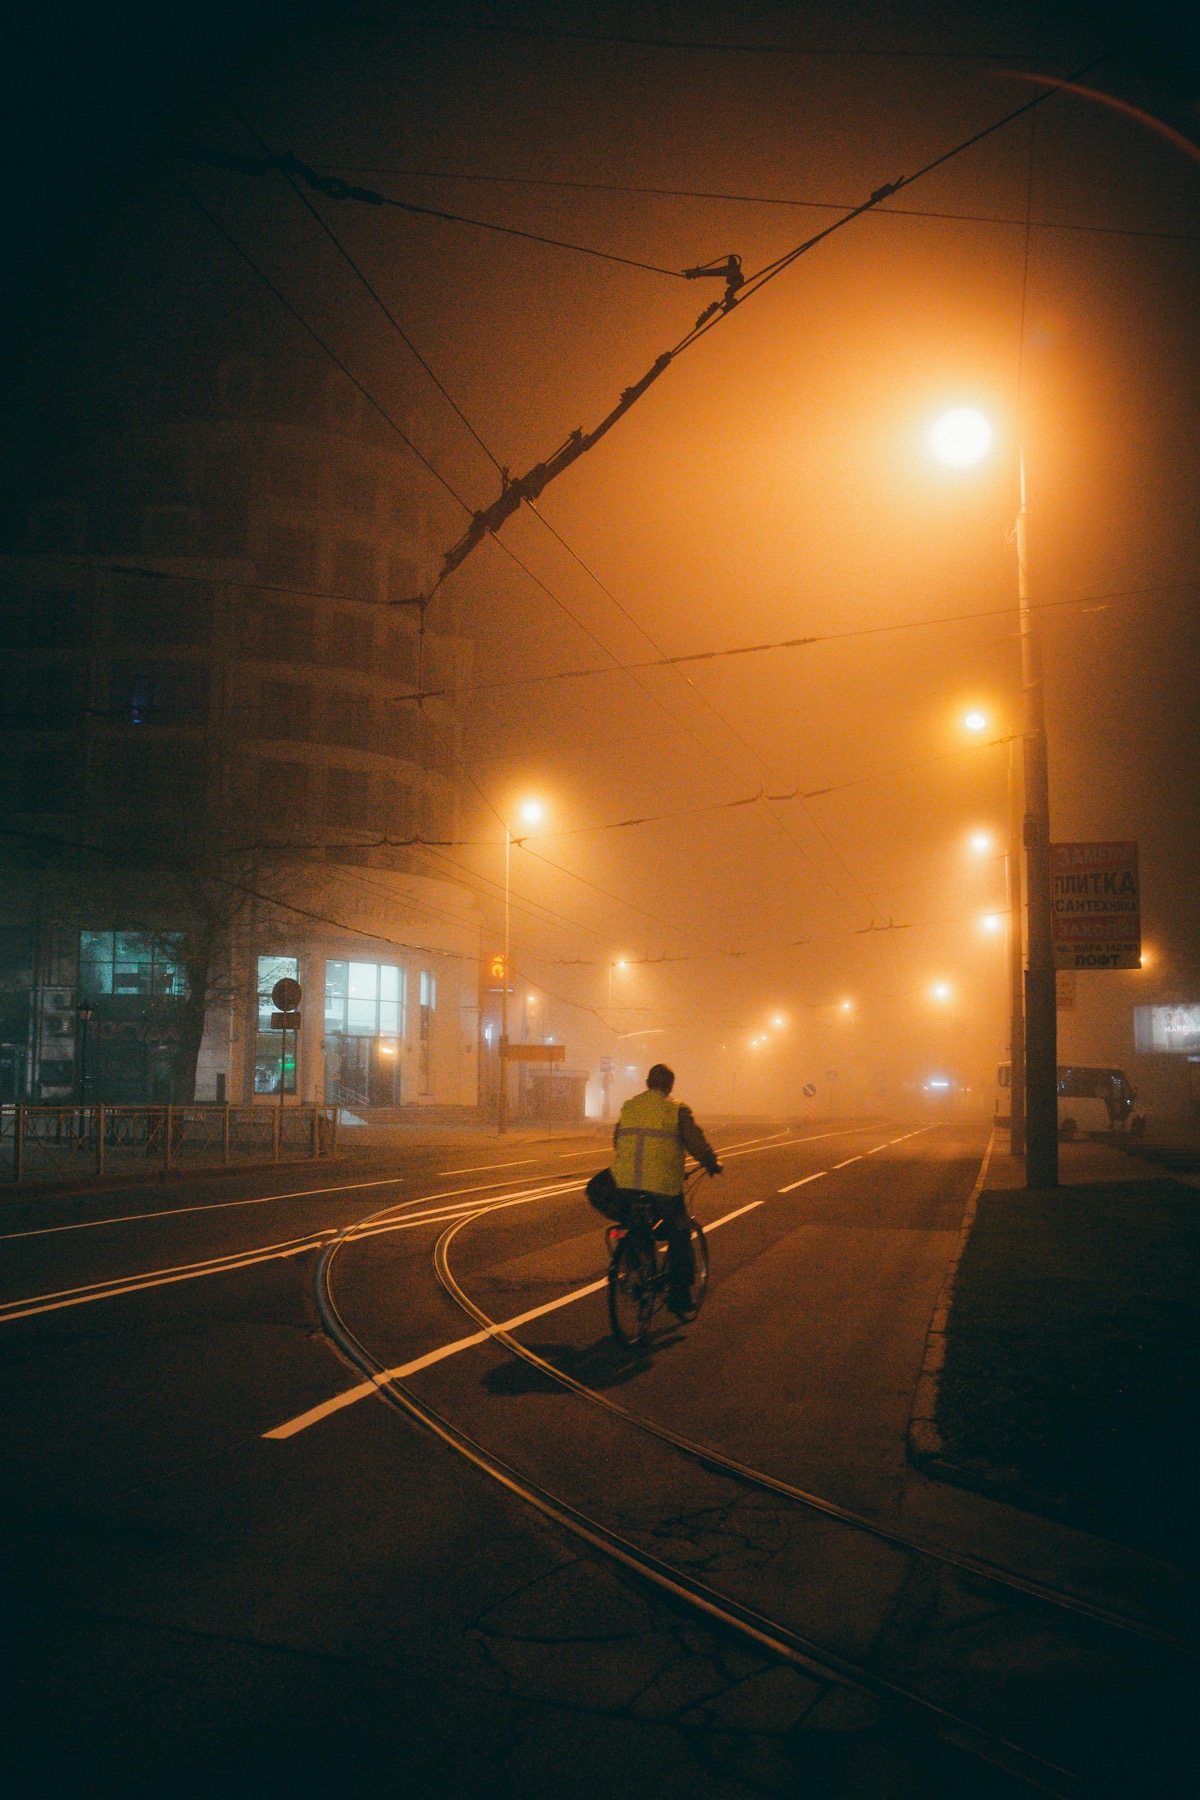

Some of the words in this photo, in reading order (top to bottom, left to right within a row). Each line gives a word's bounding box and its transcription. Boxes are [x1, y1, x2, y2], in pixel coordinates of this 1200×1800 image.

[1055, 871, 1137, 895] ПЛИТКА
[1055, 899, 1137, 912] САНТЕХНИКА
[1074, 954, 1120, 967] ЛОФТ
